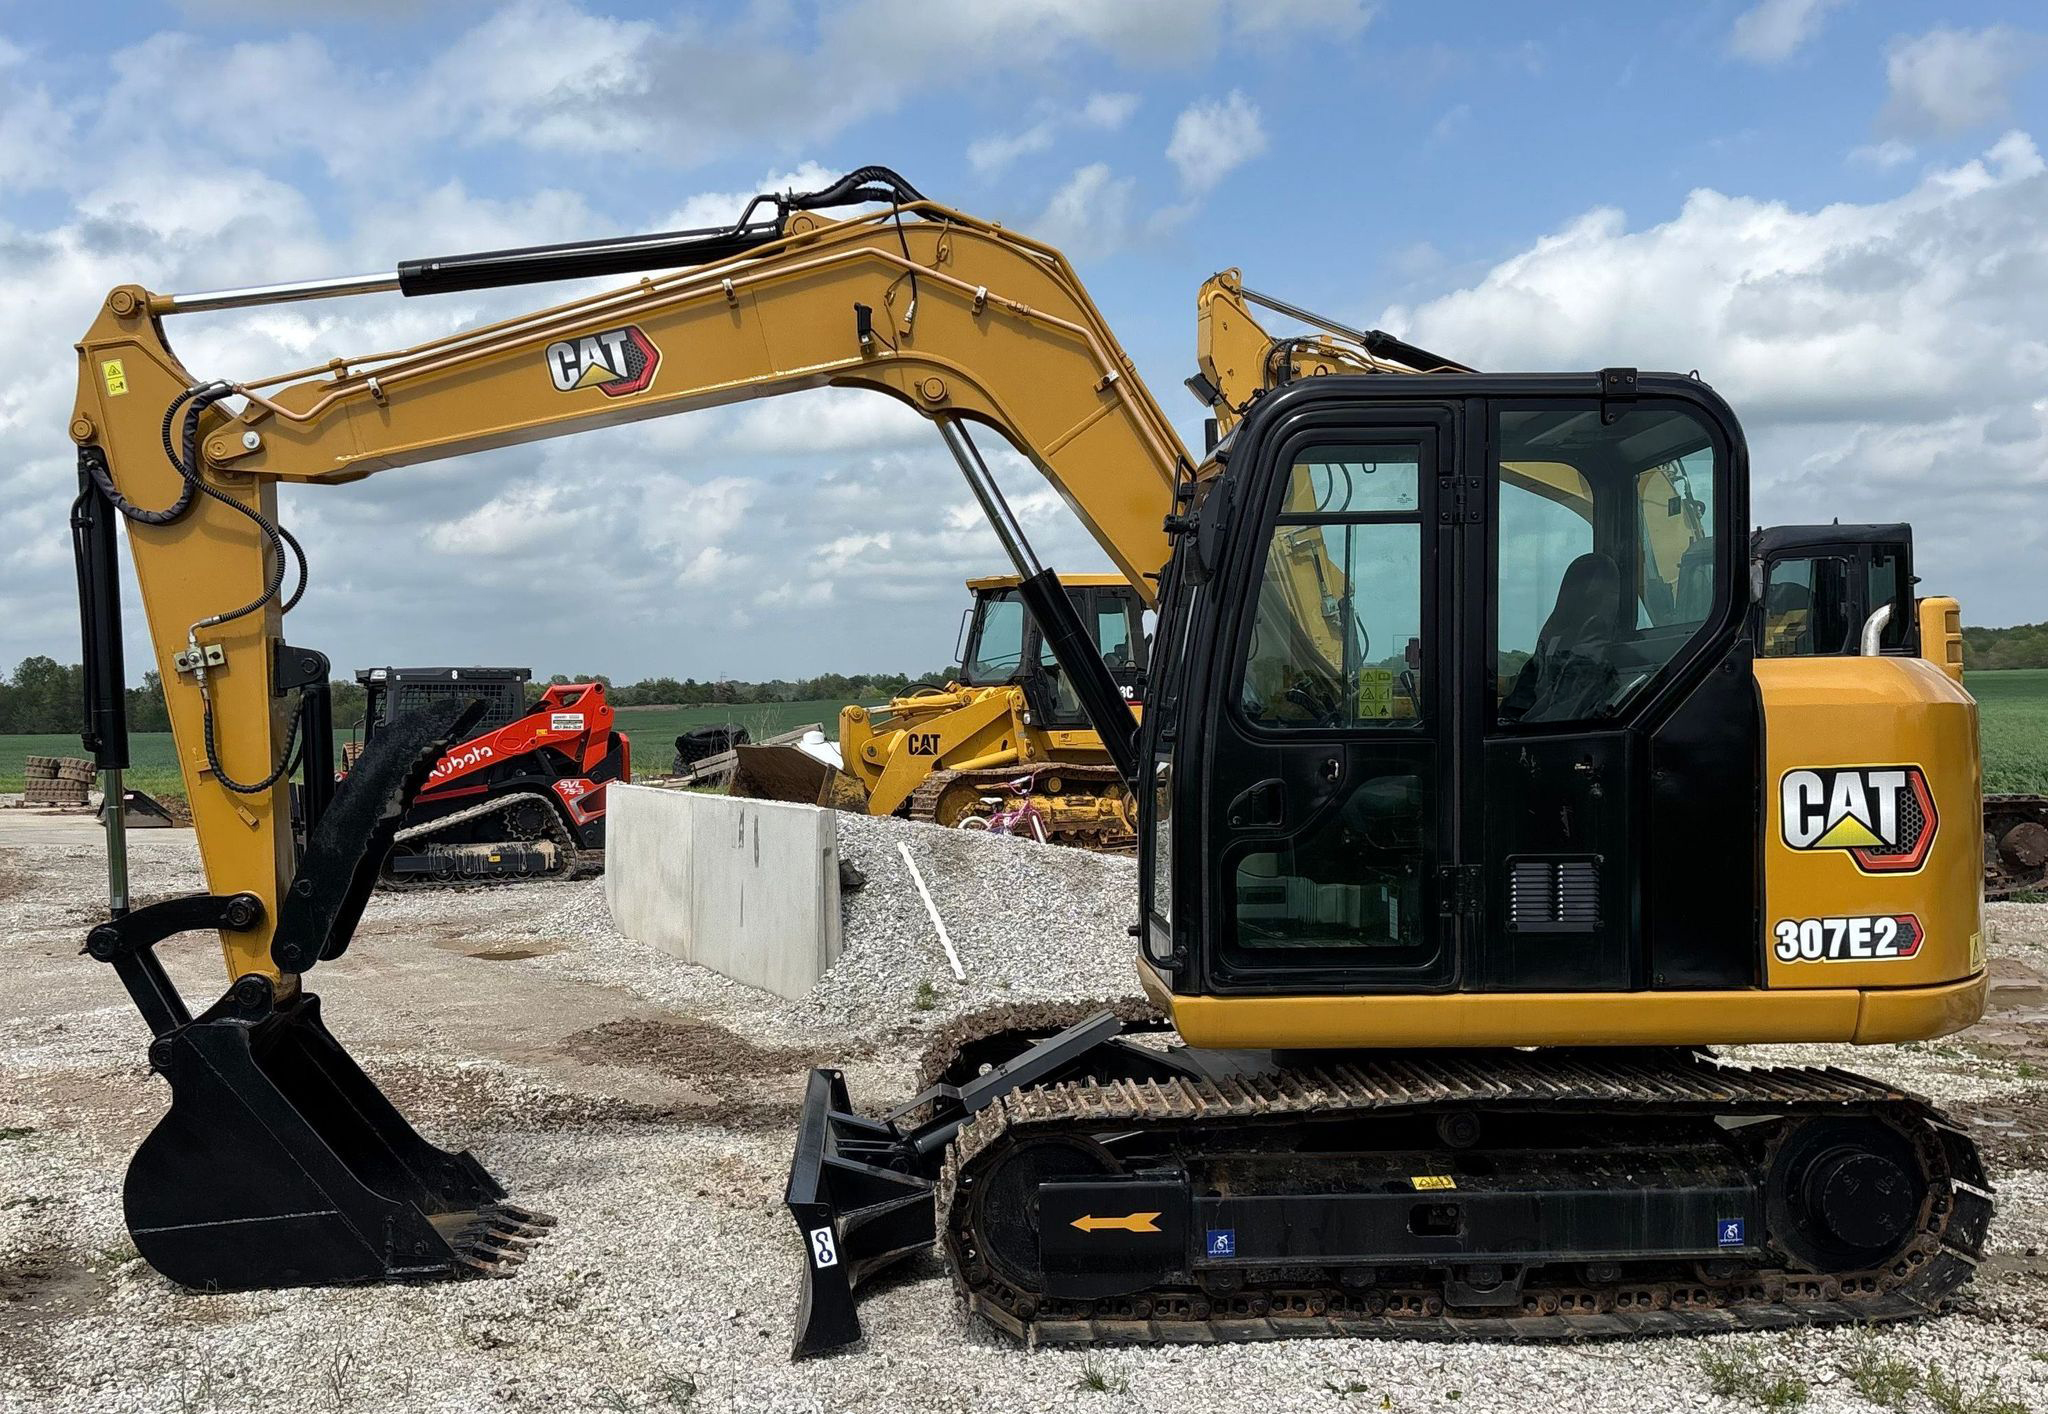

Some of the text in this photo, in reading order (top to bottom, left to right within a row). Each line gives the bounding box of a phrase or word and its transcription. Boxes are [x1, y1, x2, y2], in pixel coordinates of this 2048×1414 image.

[547, 330, 628, 390] CAT
[908, 733, 941, 756] CAT
[558, 780, 584, 789] SVL
[1782, 770, 1906, 848] CAT
[1775, 917, 1898, 960] 307E2
